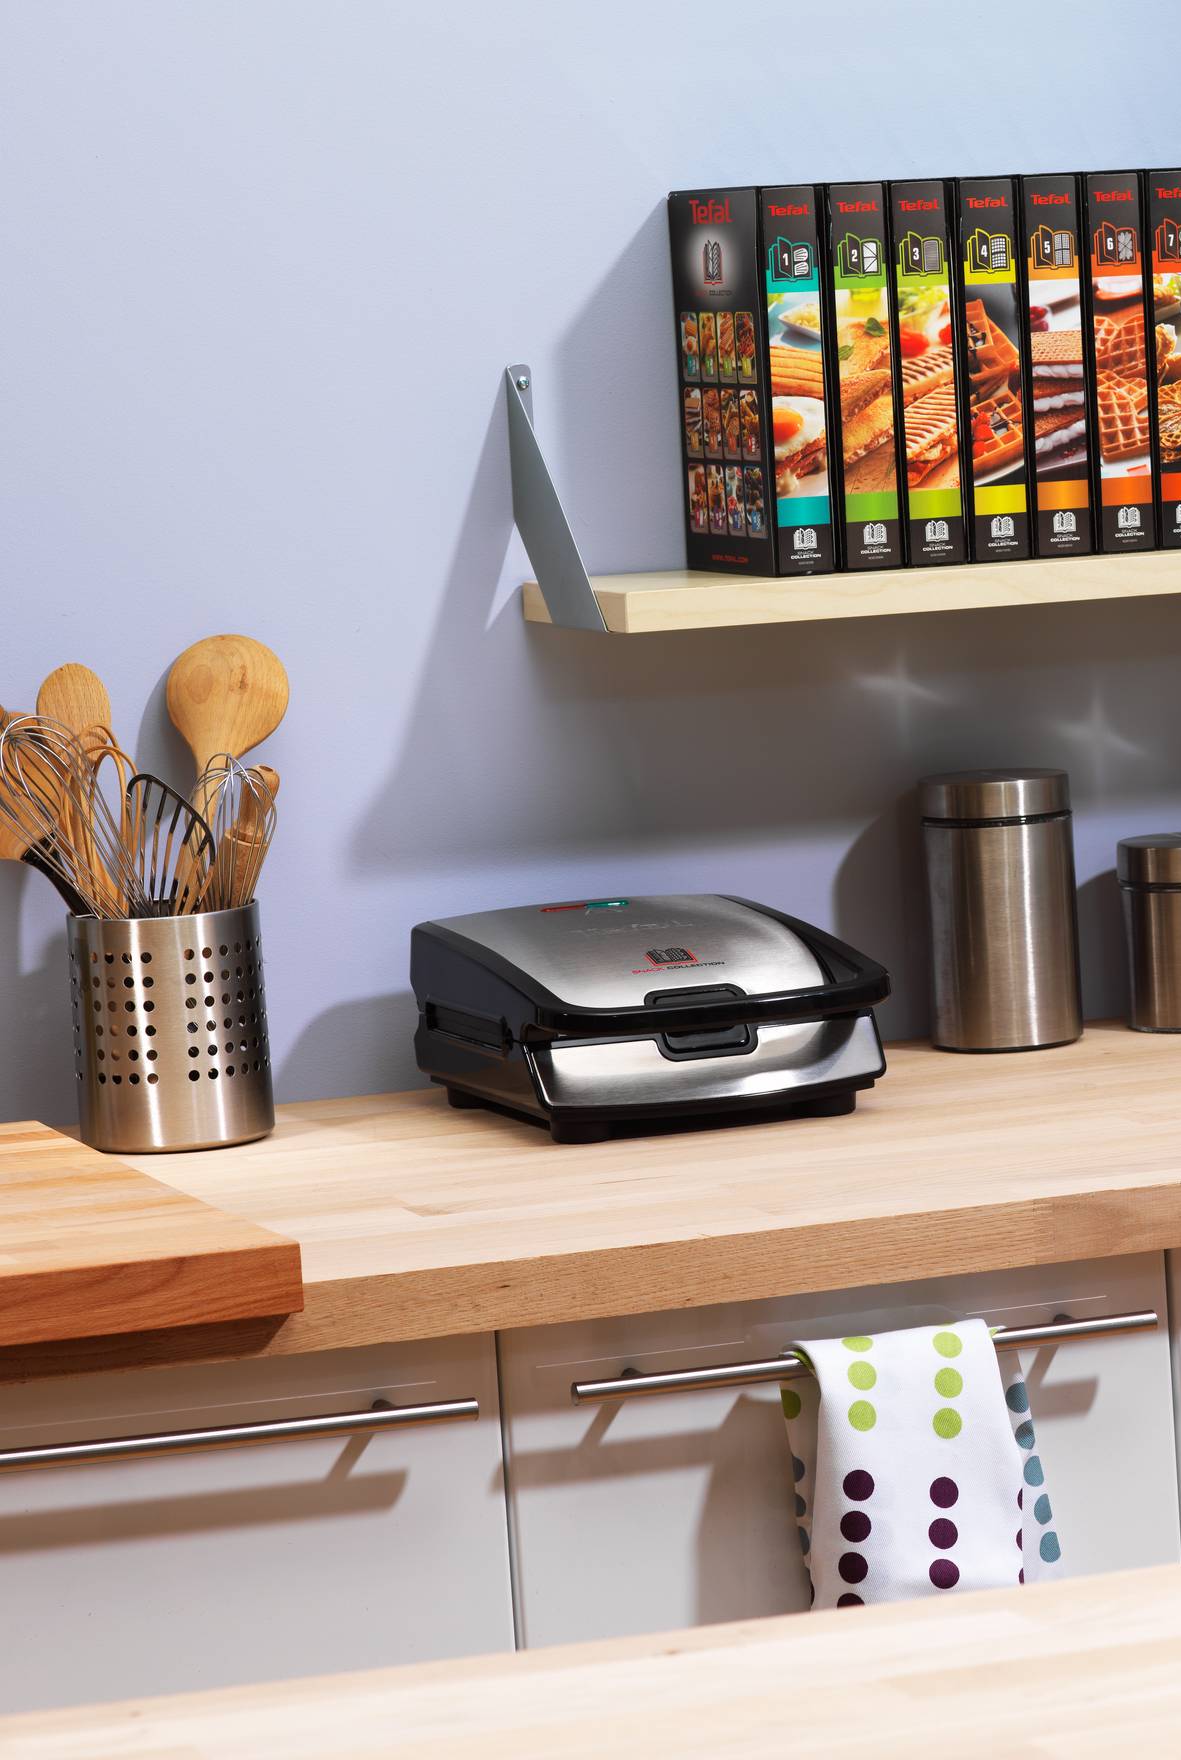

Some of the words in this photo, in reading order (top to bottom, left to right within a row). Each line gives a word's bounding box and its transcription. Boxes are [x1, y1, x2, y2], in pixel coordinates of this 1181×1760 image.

[966, 196, 1007, 208] Tefal
[1032, 193, 1070, 205] Tefal
[1093, 191, 1134, 203] Tefal
[689, 200, 732, 223] Tefal
[767, 204, 809, 216] Tefal
[836, 200, 879, 213] Tefal
[900, 199, 939, 211] Tefal
[1106, 237, 1114, 251] 6
[1167, 233, 1175, 247] 7
[980, 244, 988, 258] 4
[1043, 240, 1051, 254] 5
[782, 252, 789, 266] 1
[851, 248, 859, 263] 2
[912, 247, 920, 261] 3
[1050, 536, 1081, 544] COLLECTION
[1115, 531, 1145, 539] COLLECTION
[666, 961, 725, 970] COLLECTION
